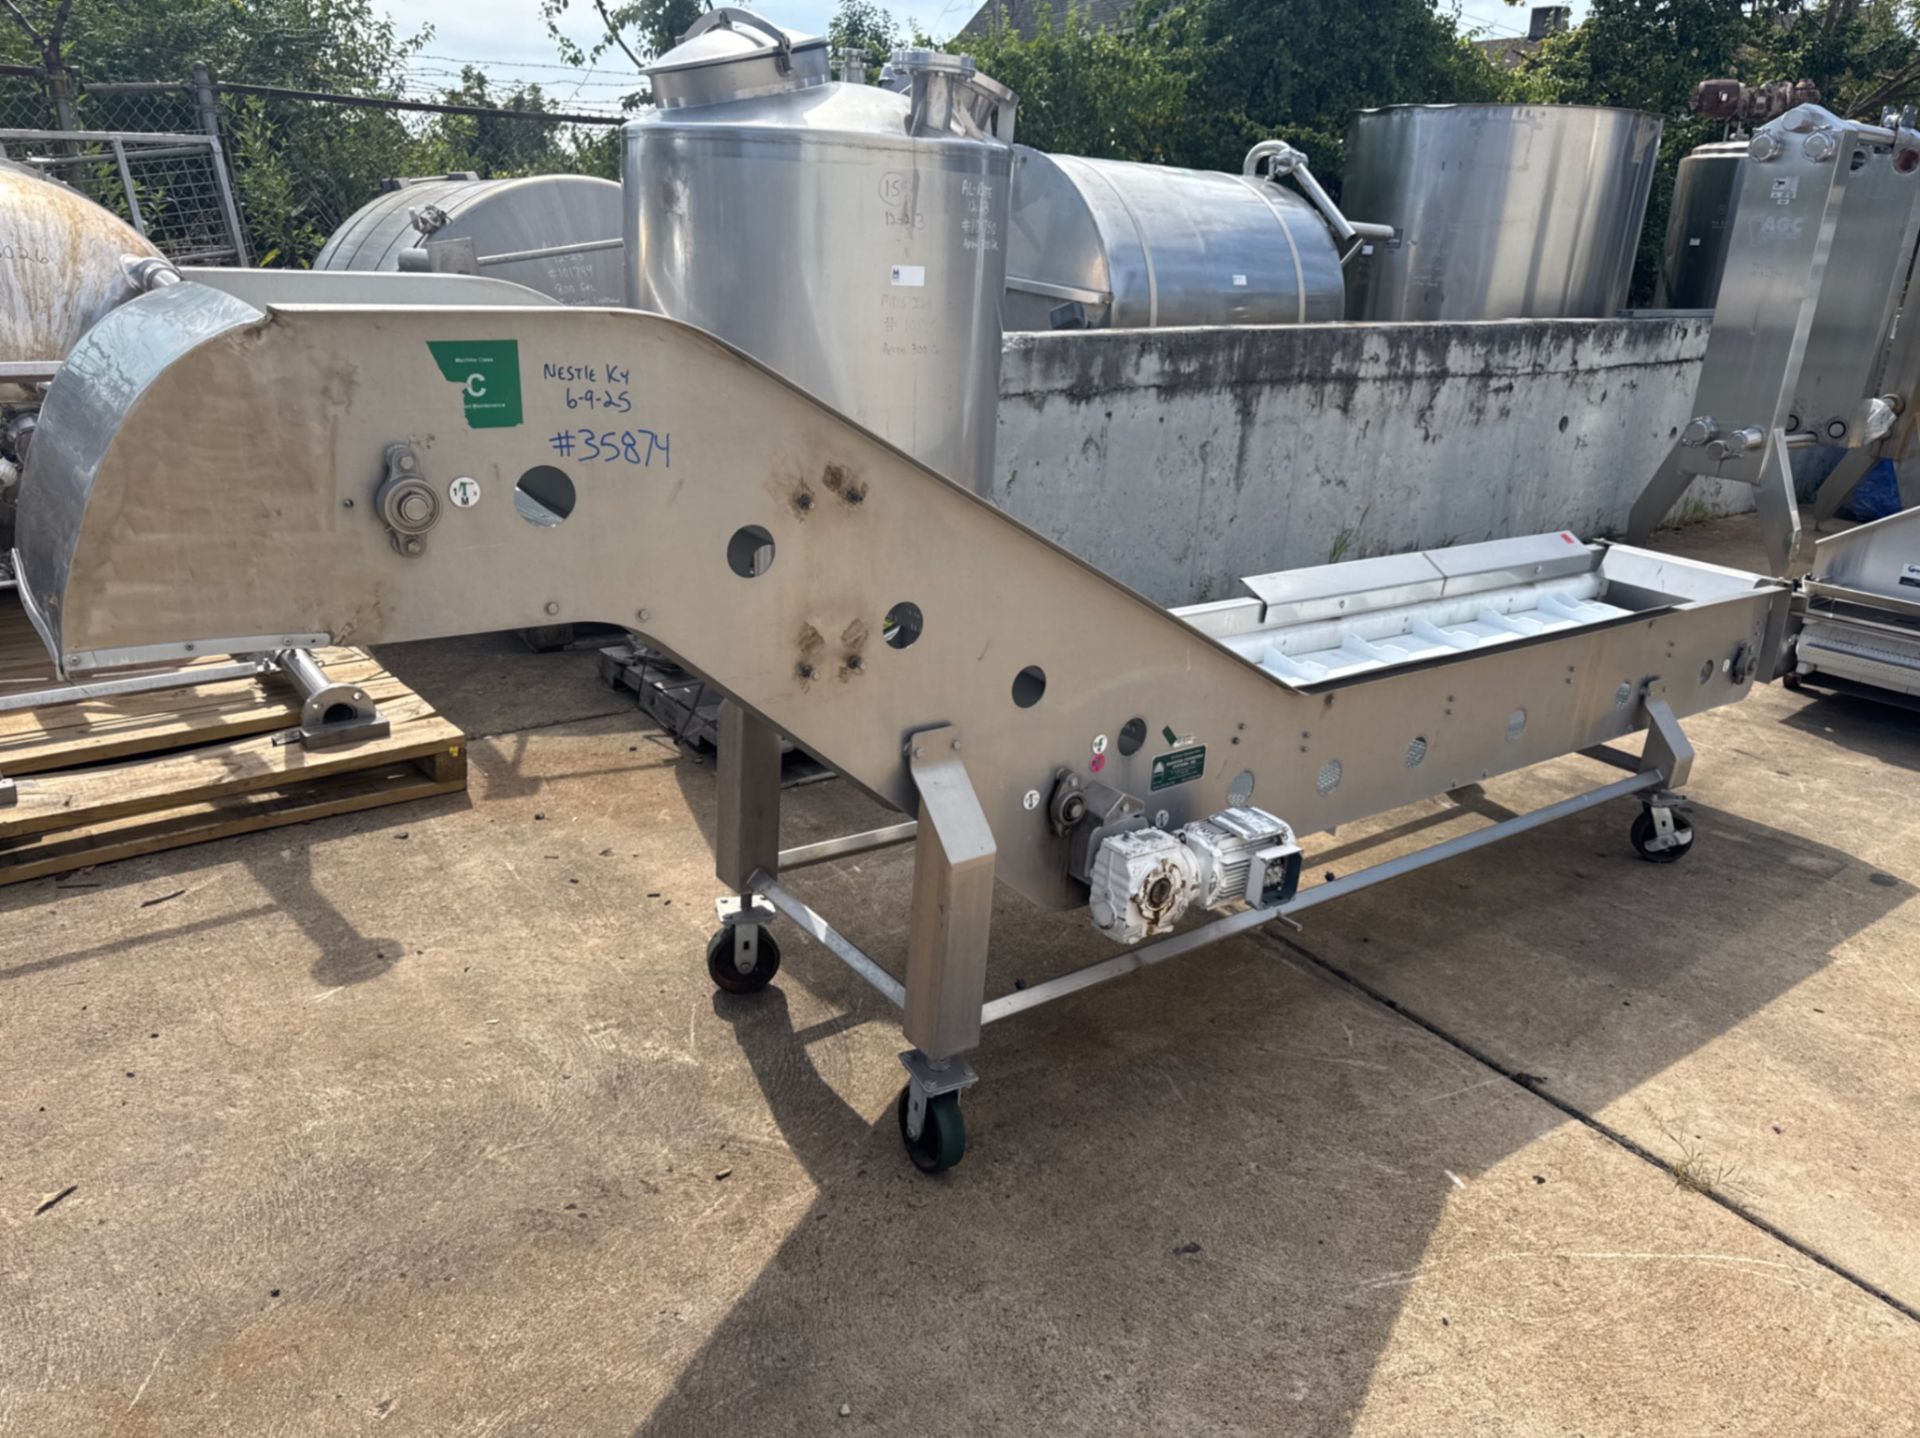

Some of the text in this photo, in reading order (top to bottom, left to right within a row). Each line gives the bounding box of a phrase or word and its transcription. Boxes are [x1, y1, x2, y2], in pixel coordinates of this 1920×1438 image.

[466, 373, 487, 397] C
[565, 387, 632, 413] 6-9-25
[549, 428, 671, 468] #35874
